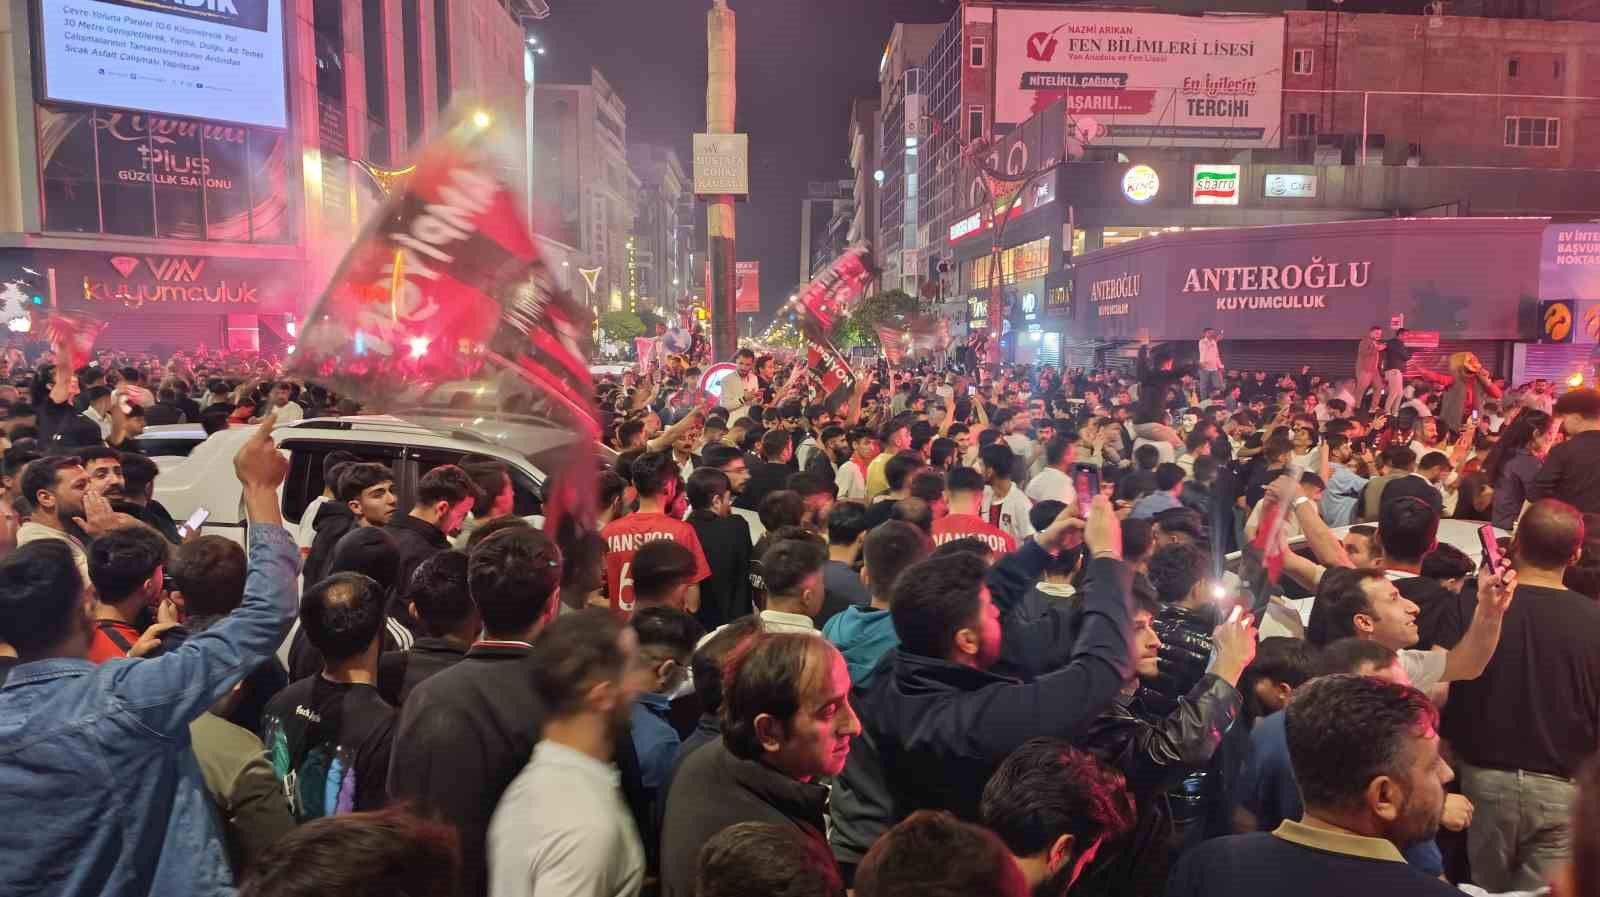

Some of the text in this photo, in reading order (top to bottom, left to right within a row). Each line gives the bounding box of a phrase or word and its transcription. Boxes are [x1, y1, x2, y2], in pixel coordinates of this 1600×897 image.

[1069, 35, 1255, 57] FEN BİLİMLERİ LİSESİ
[1183, 76, 1200, 91] En
[1067, 94, 1132, 113] AŞARILI...
[1559, 231, 1573, 241] EV
[144, 256, 208, 283] VAN
[1182, 256, 1371, 294] ANTEROĞLU
[1091, 272, 1141, 302] ANTEROĞLU
[1216, 294, 1325, 310] KUYUMCULUK
